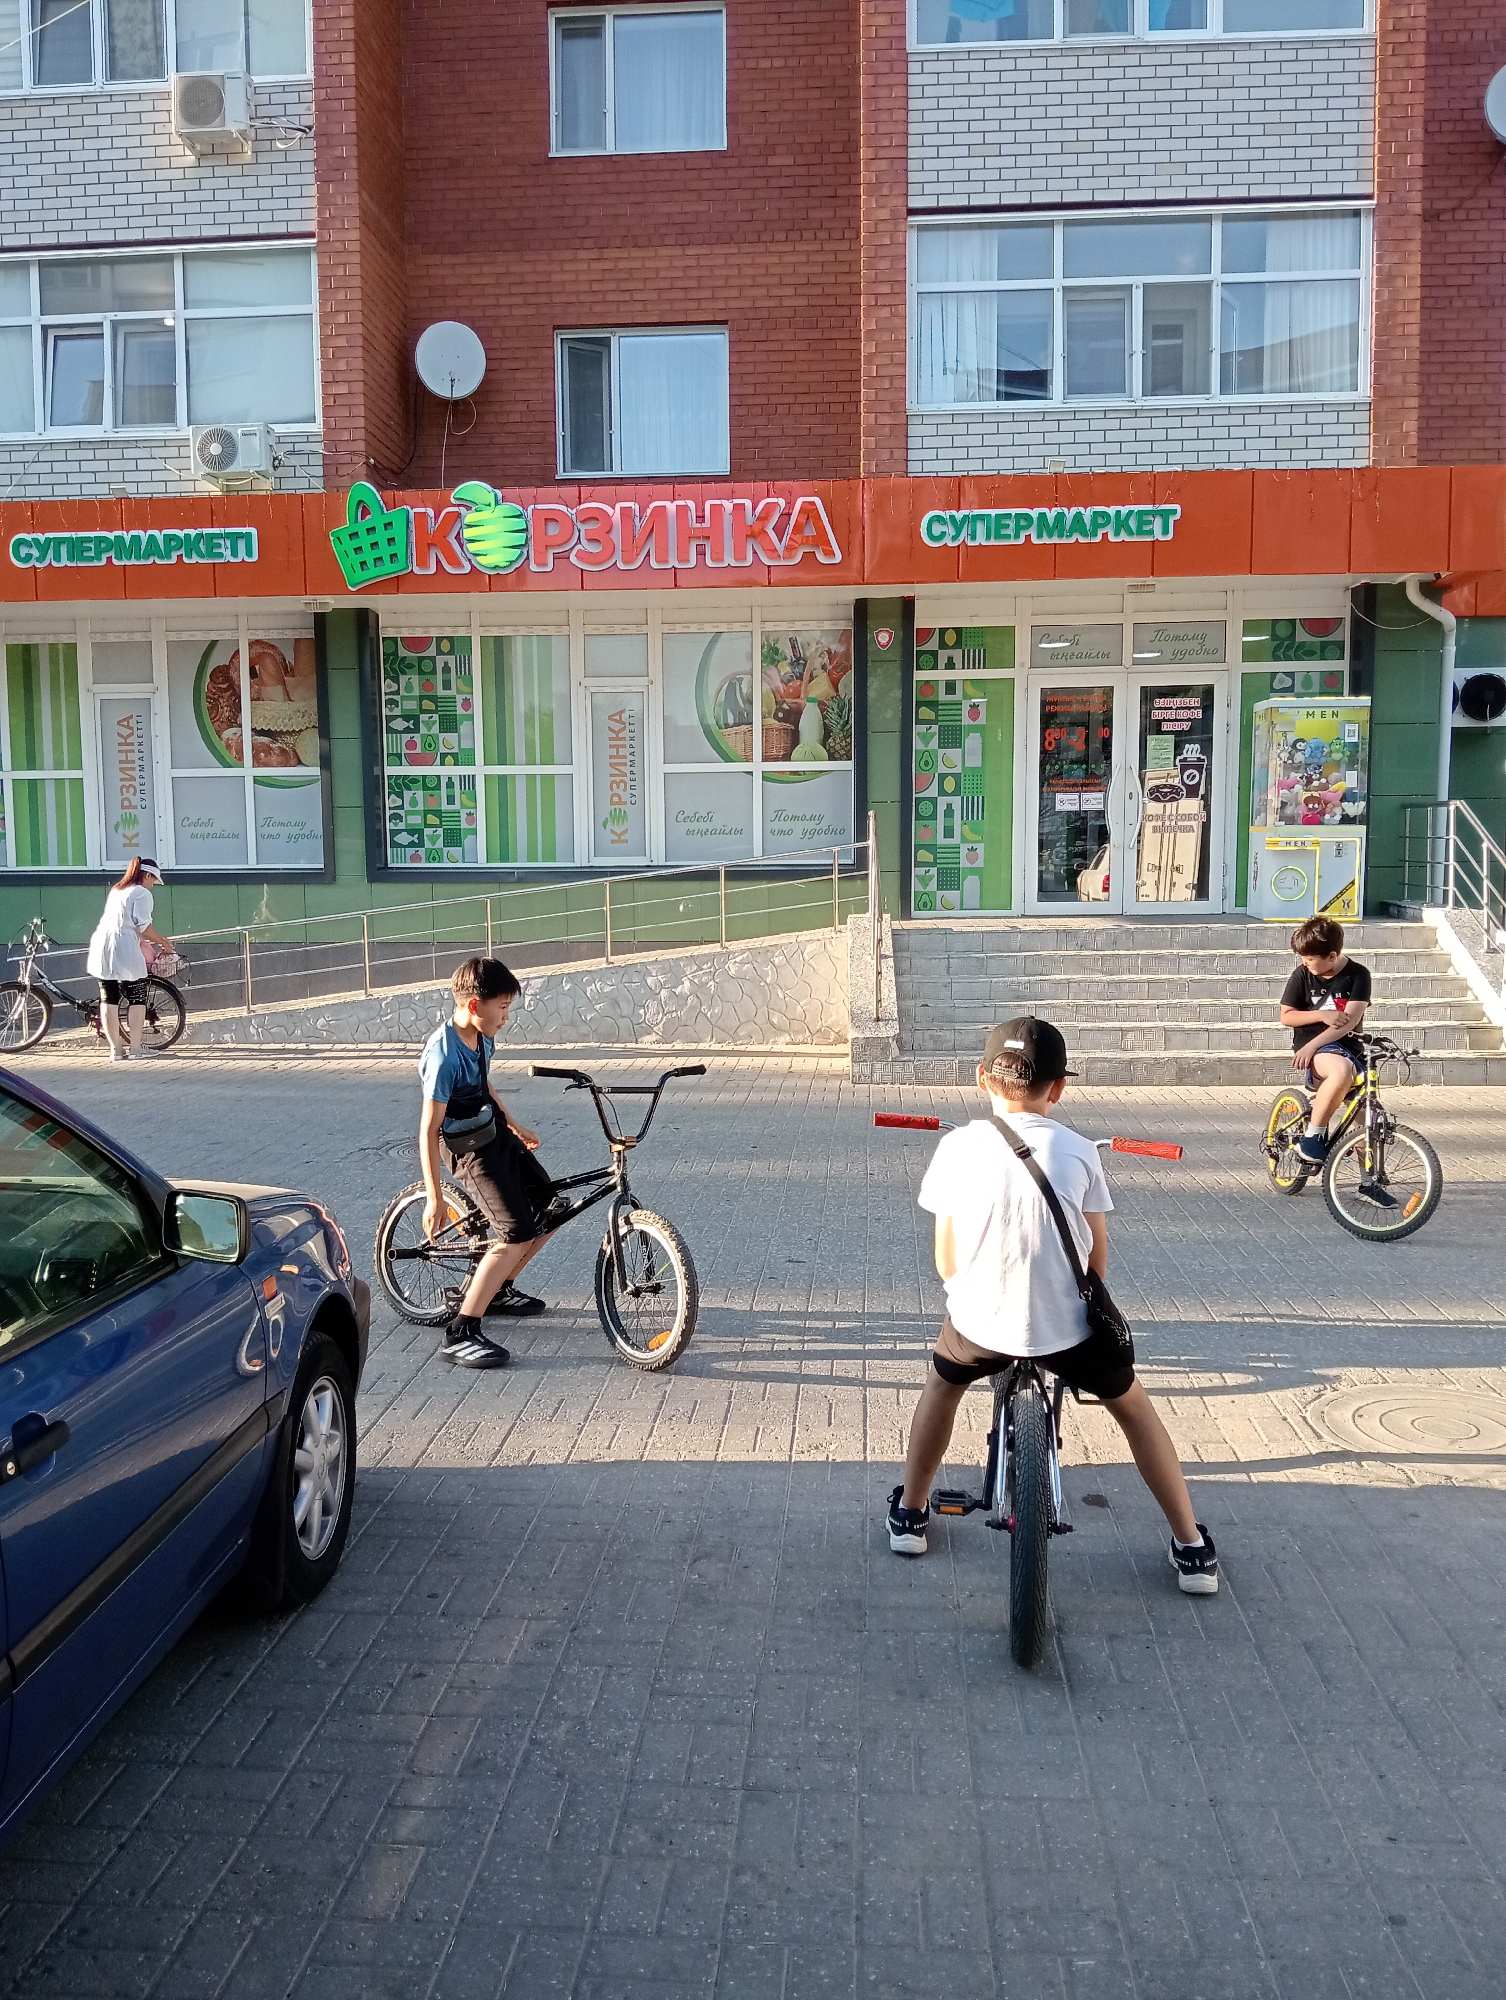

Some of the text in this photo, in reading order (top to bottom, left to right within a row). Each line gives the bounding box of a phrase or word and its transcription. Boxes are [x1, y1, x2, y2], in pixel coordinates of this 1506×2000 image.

[921, 506, 1180, 546] СУПЕРМАРКЕТ
[10, 529, 257, 567] СУПЕРМАРКЕТІ
[1150, 629, 1208, 645] Потому
[1050, 650, 1111, 662] ыңғайлы
[1170, 643, 1219, 661] удобно
[1151, 709, 1203, 719] БІРГЕ КОФЕ
[1306, 710, 1339, 719] MEN
[1161, 722, 1191, 731] ПІСІРУ
[136, 714, 147, 810] СУПЕРМАРКЕТТІ
[628, 708, 637, 806] СУПЕРМАРКЕТТІ
[180, 816, 215, 828] Себебі
[675, 810, 715, 823] Себебі
[770, 809, 825, 825] Потому
[1142, 813, 1166, 823] КОФЕ
[1176, 811, 1206, 822] СОБОЙ
[260, 816, 307, 831] Потому
[1152, 824, 1195, 834] ВЫПЕЧКА
[190, 829, 240, 840] ыңғайлы
[260, 832, 281, 840] что
[685, 825, 743, 838] ыңғайлы
[800, 825, 846, 840] удобно
[1285, 840, 1307, 848] MEN
